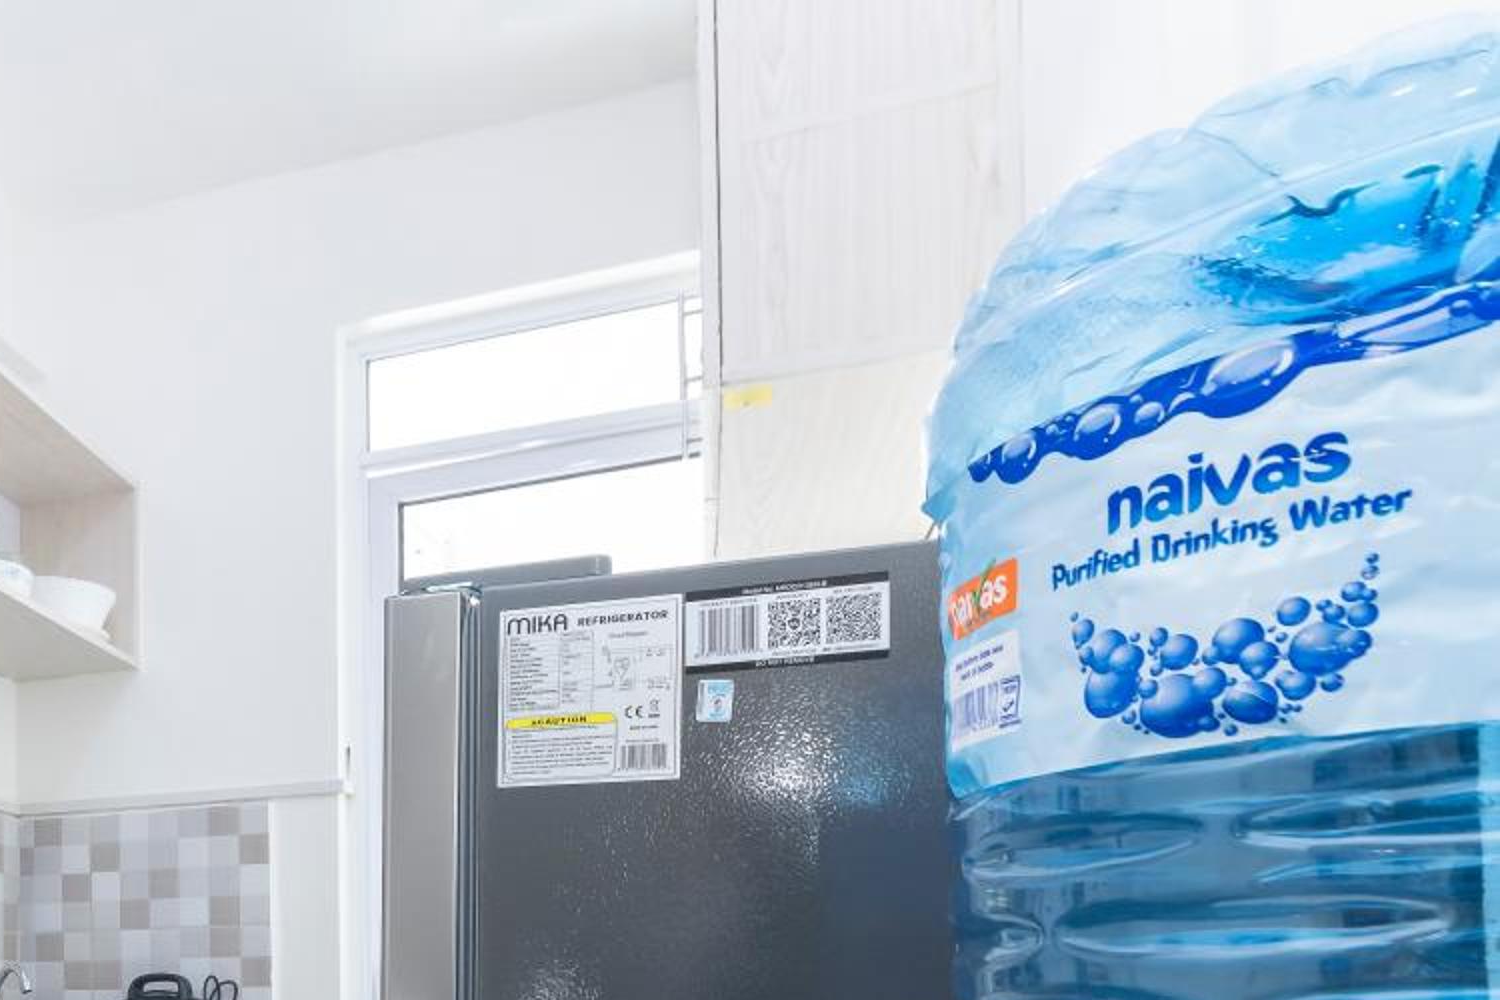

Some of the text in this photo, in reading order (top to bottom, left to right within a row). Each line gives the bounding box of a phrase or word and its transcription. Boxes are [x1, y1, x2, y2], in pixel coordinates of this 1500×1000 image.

[1105, 430, 1353, 535] naivas
[1051, 488, 1413, 592] Purified Drinking Water
[507, 613, 568, 636] MIKA
[576, 609, 669, 627] REFRIGERATOR
